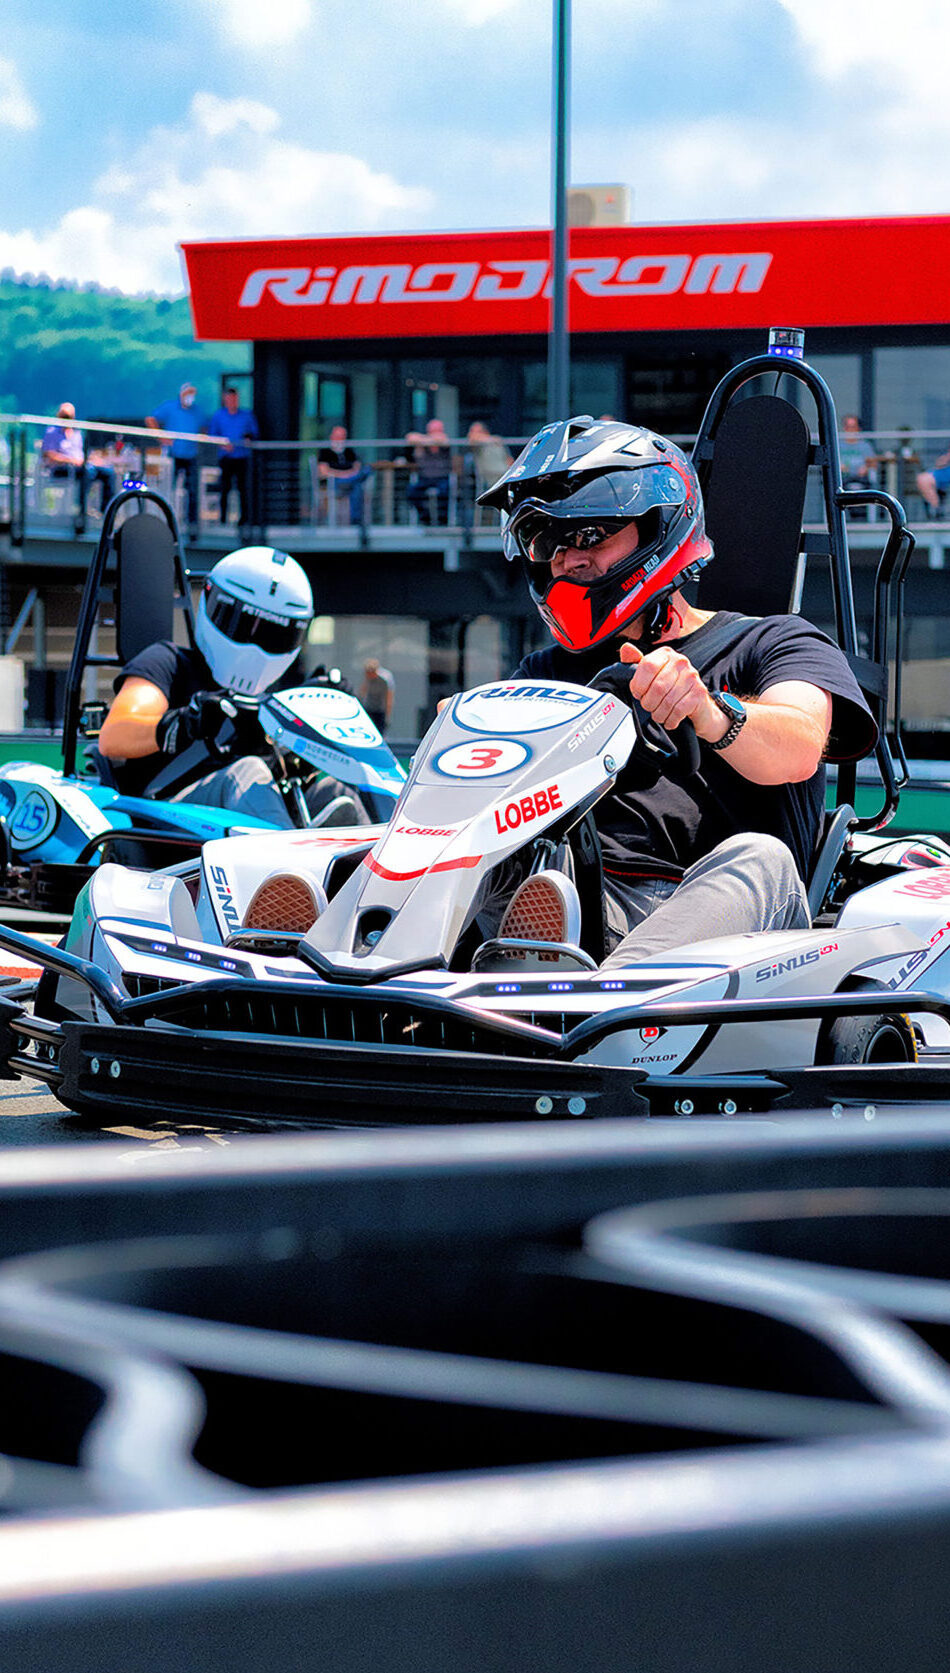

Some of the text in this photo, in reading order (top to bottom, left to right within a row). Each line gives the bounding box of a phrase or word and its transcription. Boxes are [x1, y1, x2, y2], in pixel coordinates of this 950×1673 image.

[456, 748, 503, 770] 3
[14, 804, 45, 832] 15
[494, 784, 563, 835] LOBBE
[395, 826, 457, 837] LOBBE
[631, 1054, 678, 1065] DUNLOP
